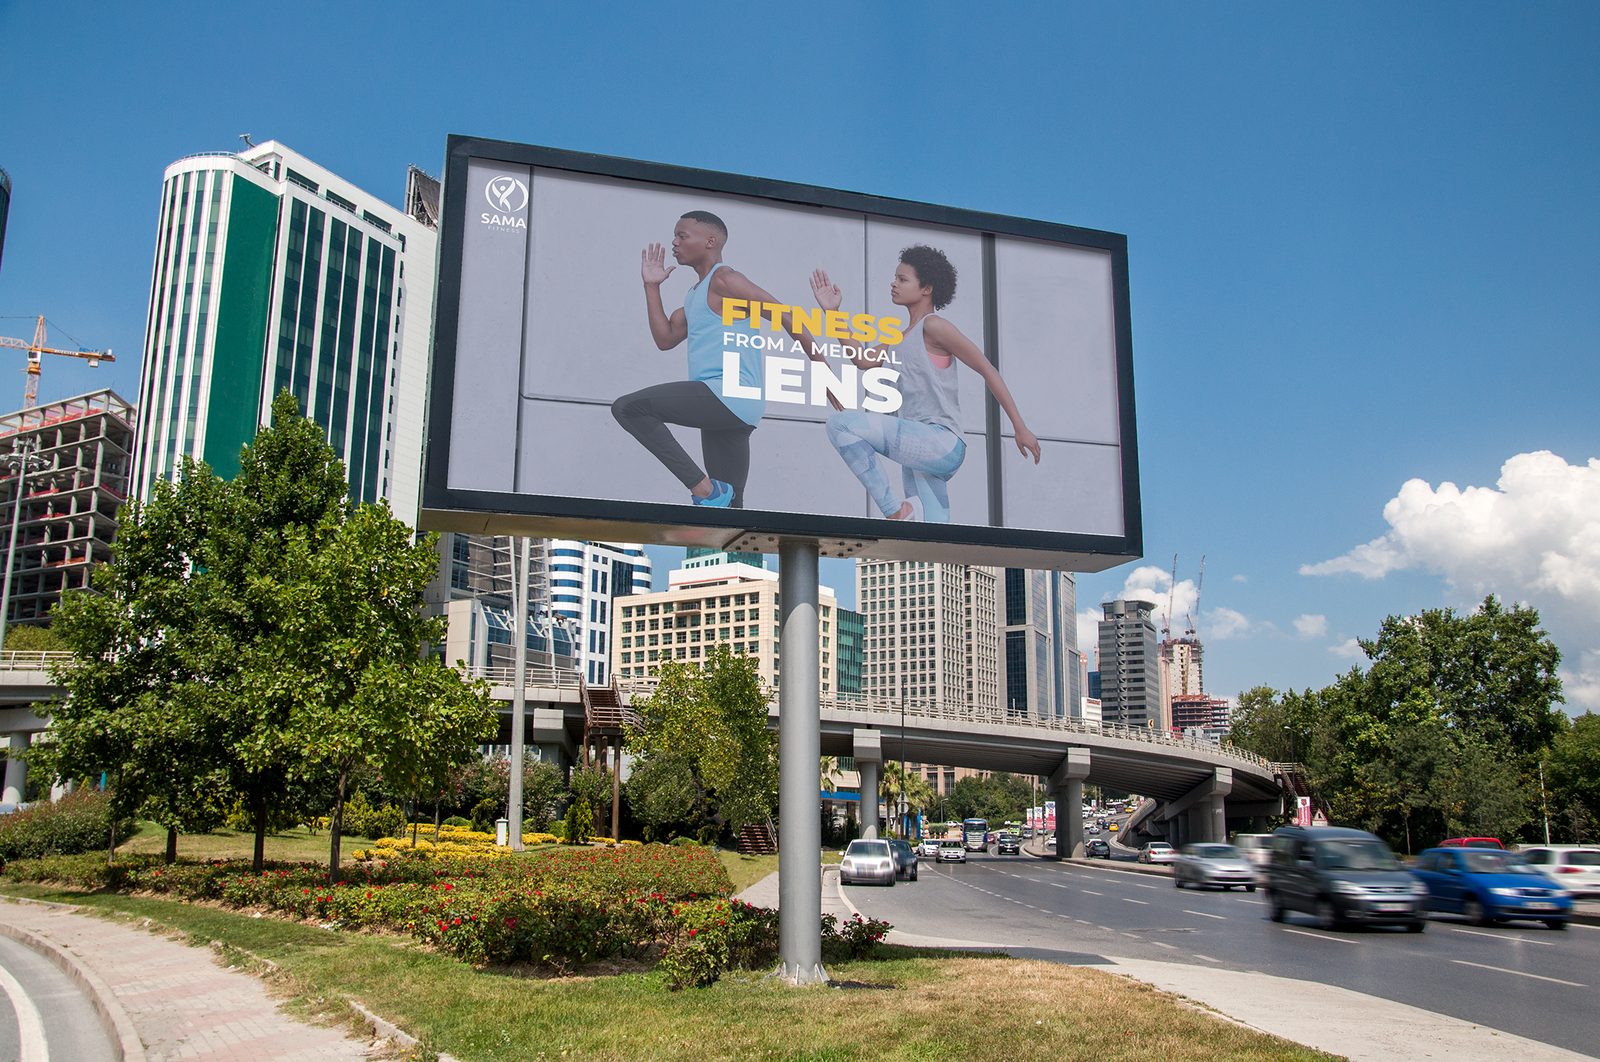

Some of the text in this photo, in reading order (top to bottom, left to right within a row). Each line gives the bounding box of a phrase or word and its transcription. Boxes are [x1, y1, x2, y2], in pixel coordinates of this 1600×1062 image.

[481, 213, 527, 229] SAMA
[722, 297, 904, 345] FITNESS
[723, 332, 902, 365] FROM A MEDICAL
[722, 351, 903, 414] LENS
